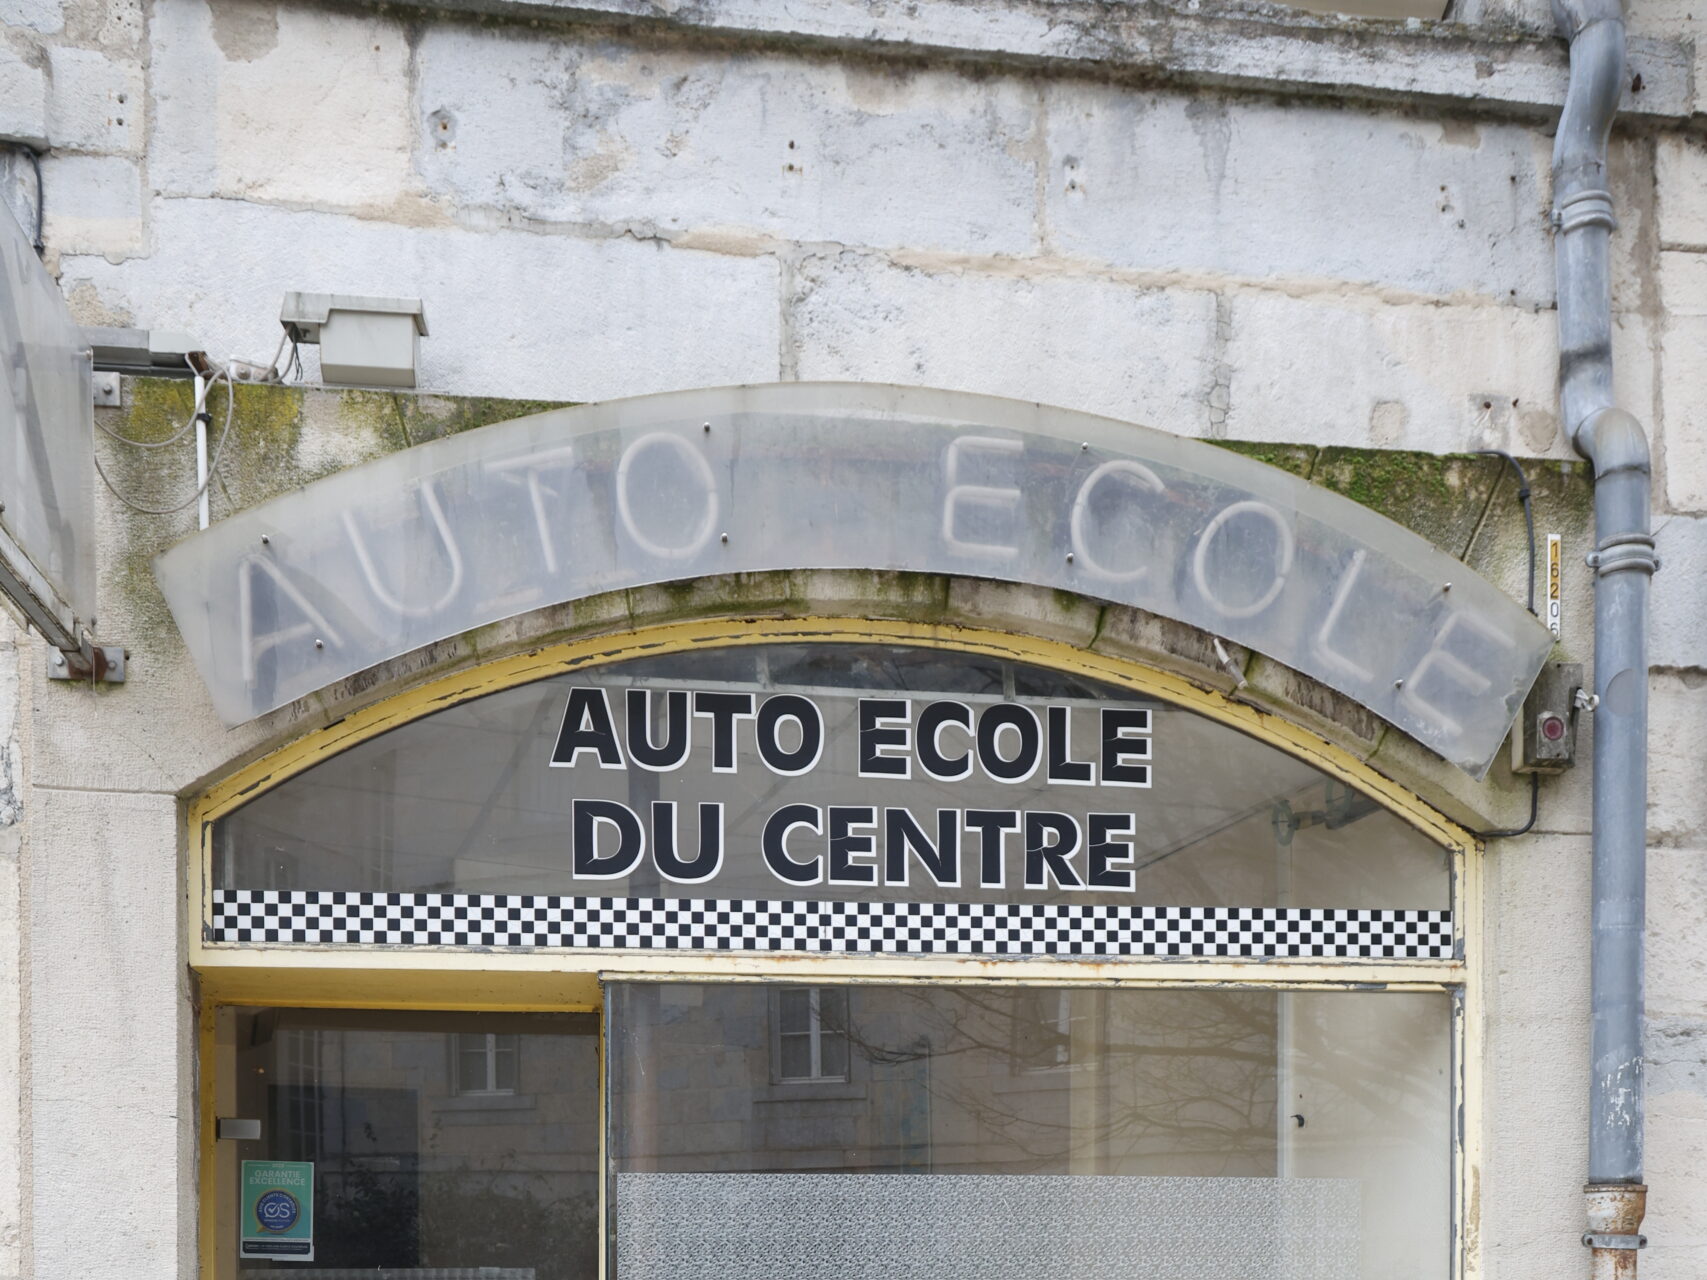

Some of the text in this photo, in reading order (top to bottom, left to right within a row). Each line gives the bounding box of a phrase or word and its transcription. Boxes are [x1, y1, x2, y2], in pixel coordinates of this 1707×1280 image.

[239, 431, 1517, 738] AUTO ECOLE
[549, 687, 1153, 788] AUTO ECOLE
[572, 798, 1137, 893] DU CENTRE
[249, 1177, 305, 1185] EXCELLENCE
[254, 1169, 301, 1178] GARANTIE
